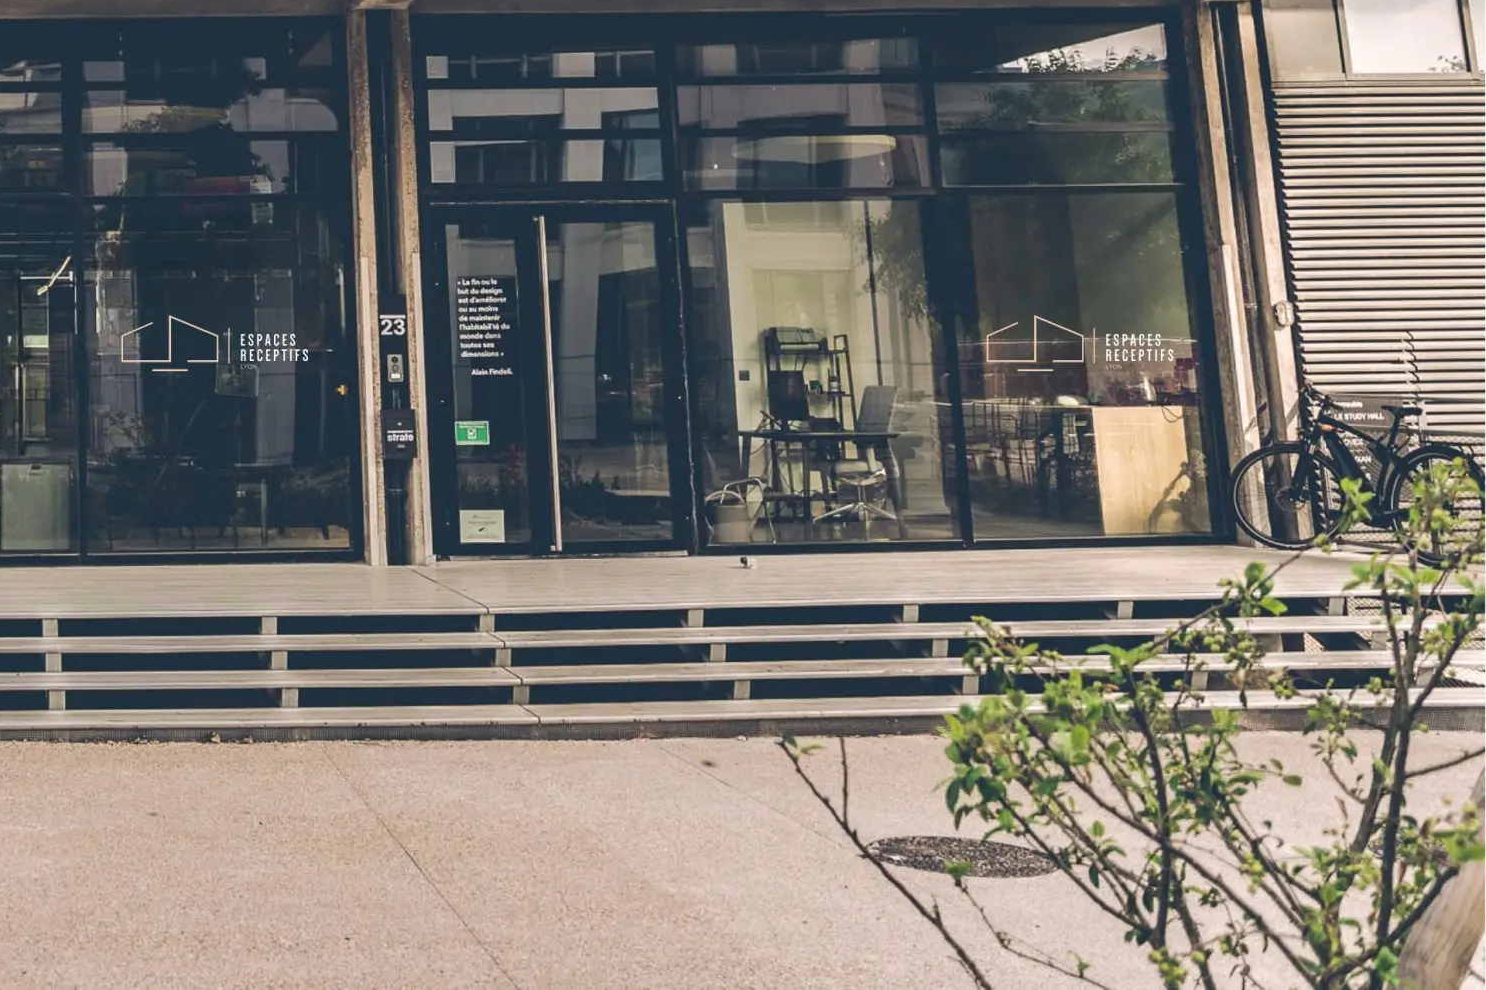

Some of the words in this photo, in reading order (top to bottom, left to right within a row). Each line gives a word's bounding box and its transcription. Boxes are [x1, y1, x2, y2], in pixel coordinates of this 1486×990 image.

[480, 287, 503, 295] design
[380, 319, 406, 335] 23
[240, 333, 296, 347] ESPACES
[1105, 333, 1162, 347] ESPACES
[240, 348, 309, 361] RECEPTIFS
[1105, 348, 1174, 361] RECEPTIFS
[1344, 413, 1366, 421] STUDY
[1367, 412, 1384, 420] HALL
[387, 433, 414, 441] strate
